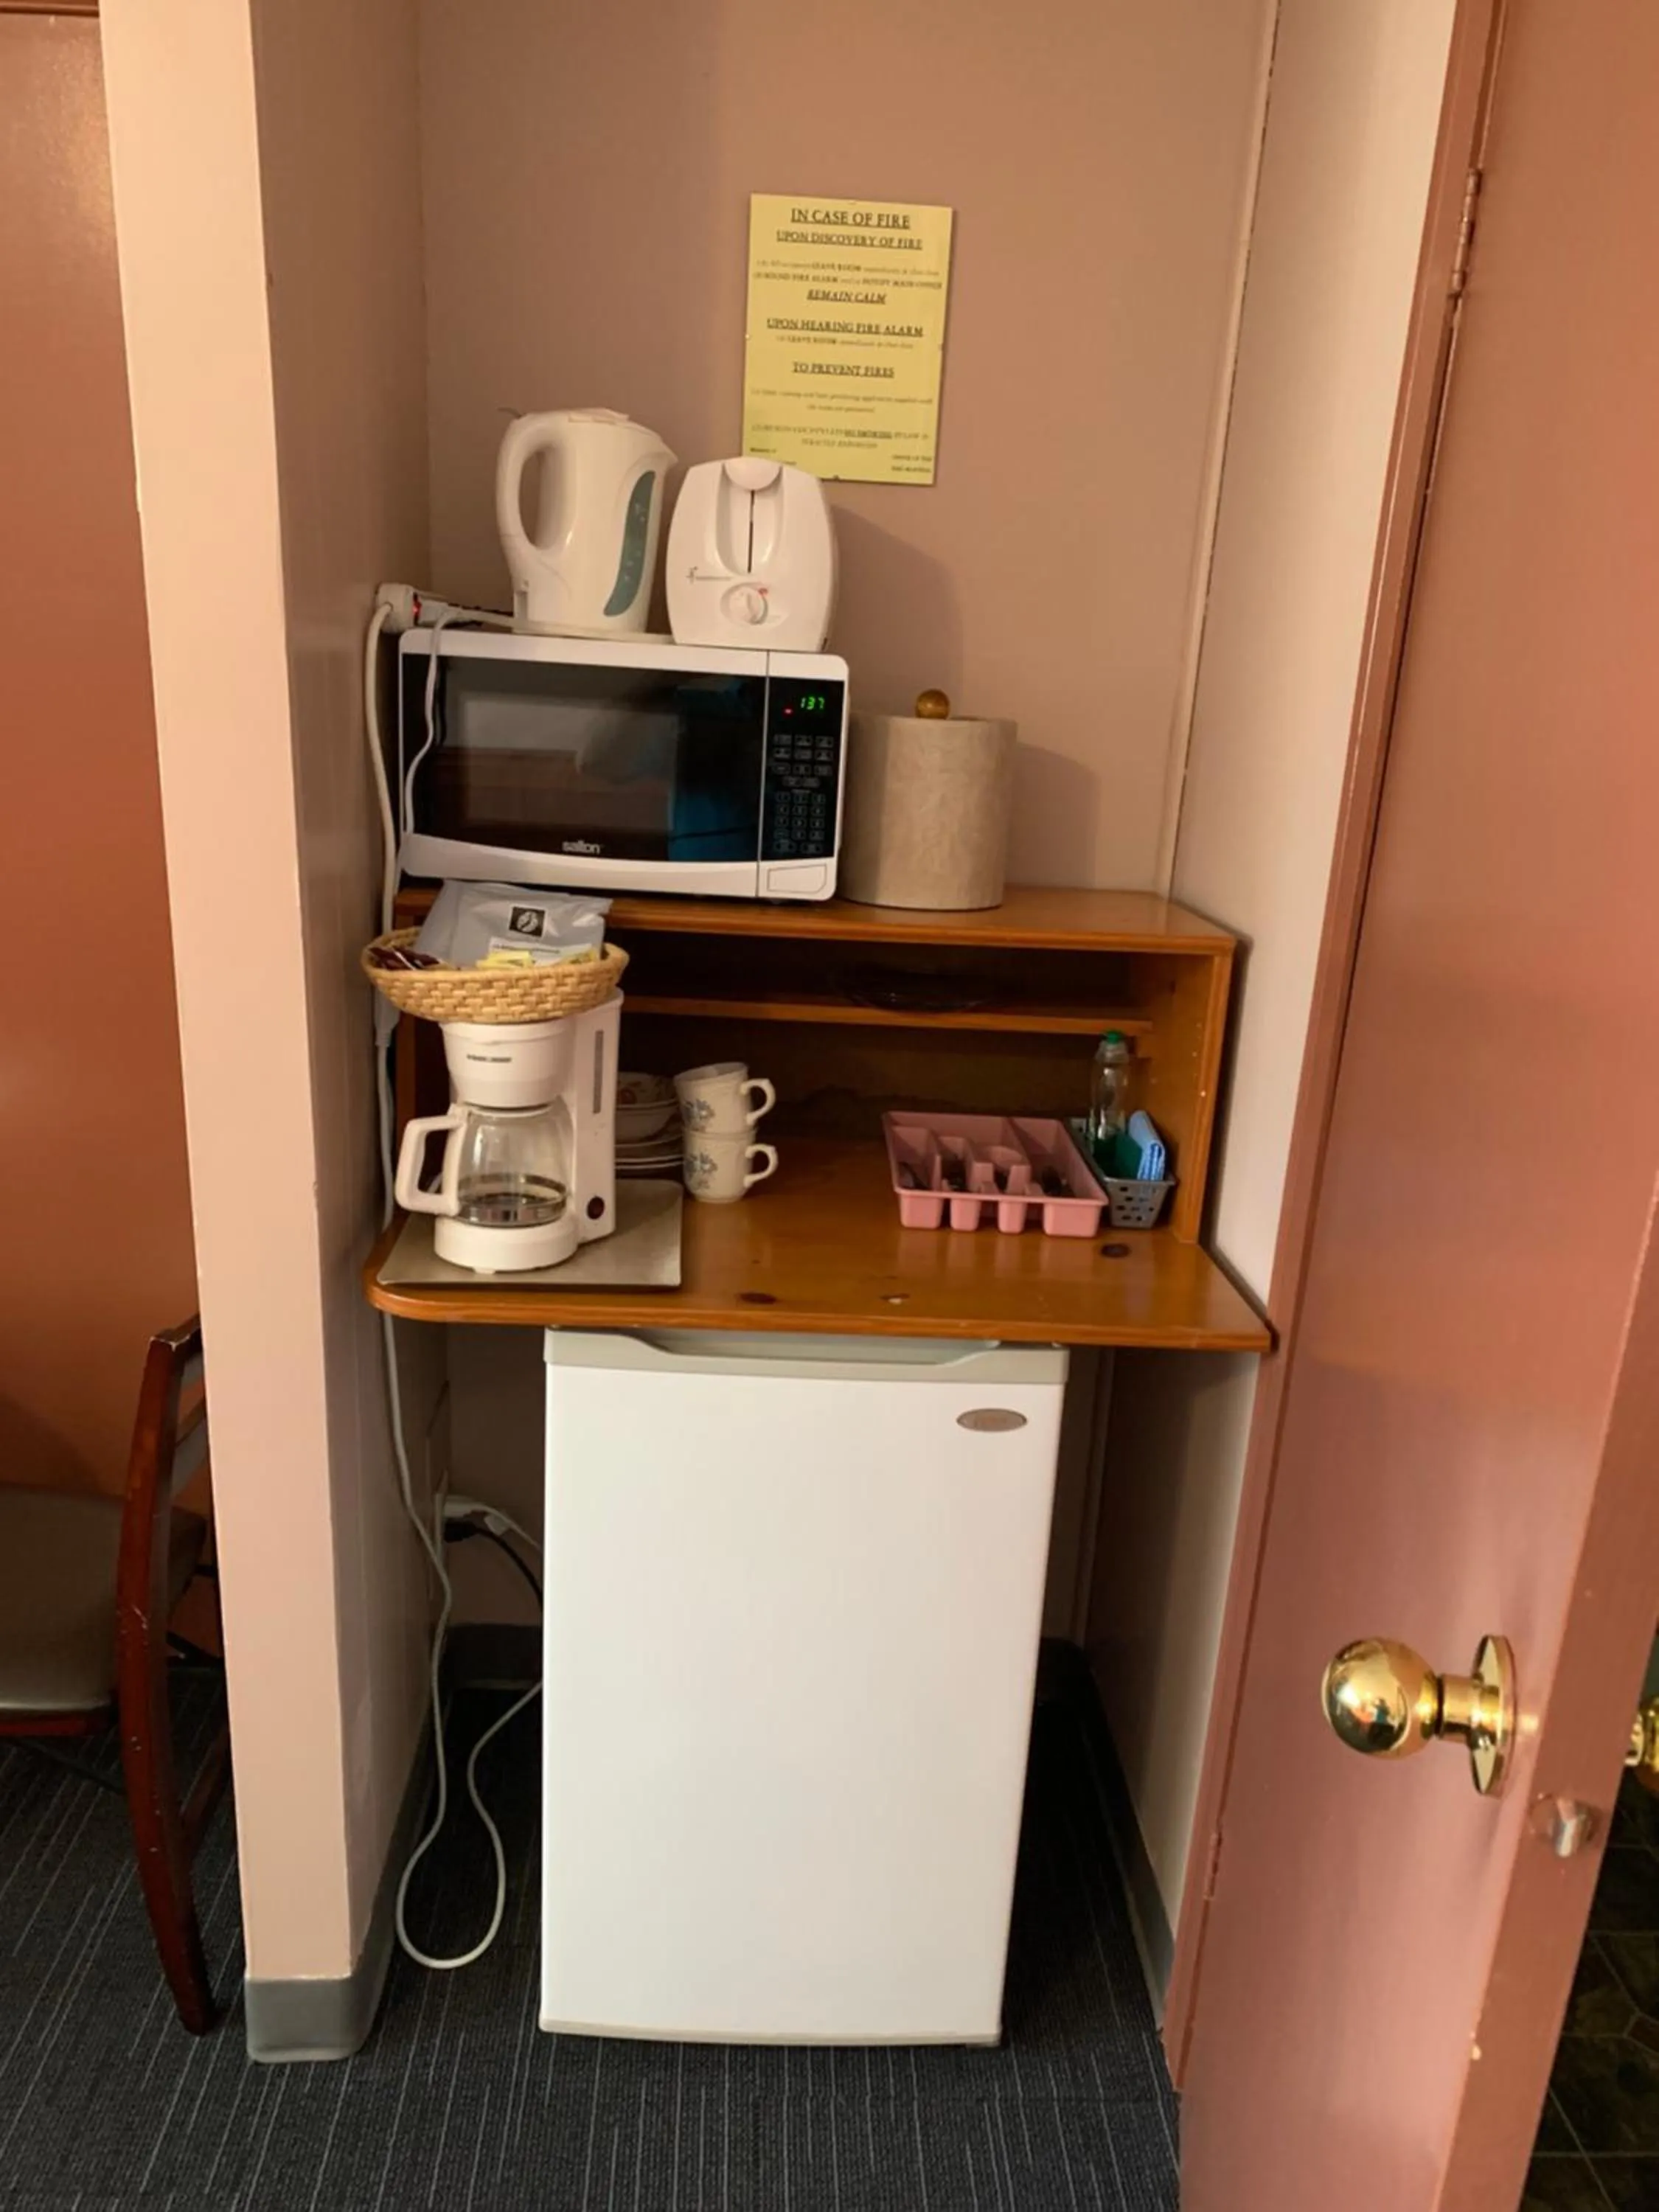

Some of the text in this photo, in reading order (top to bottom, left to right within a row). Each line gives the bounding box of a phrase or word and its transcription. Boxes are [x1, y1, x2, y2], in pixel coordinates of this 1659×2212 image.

[790, 208, 911, 229] IN CASE OF FIRE
[776, 230, 923, 250] UPON DISCOVERY OF FIRE
[807, 288, 887, 305] REMAIN CALM
[767, 318, 924, 337] UPON HEARING FIRE ALARM
[793, 361, 895, 378] TO PREVENT FIRES
